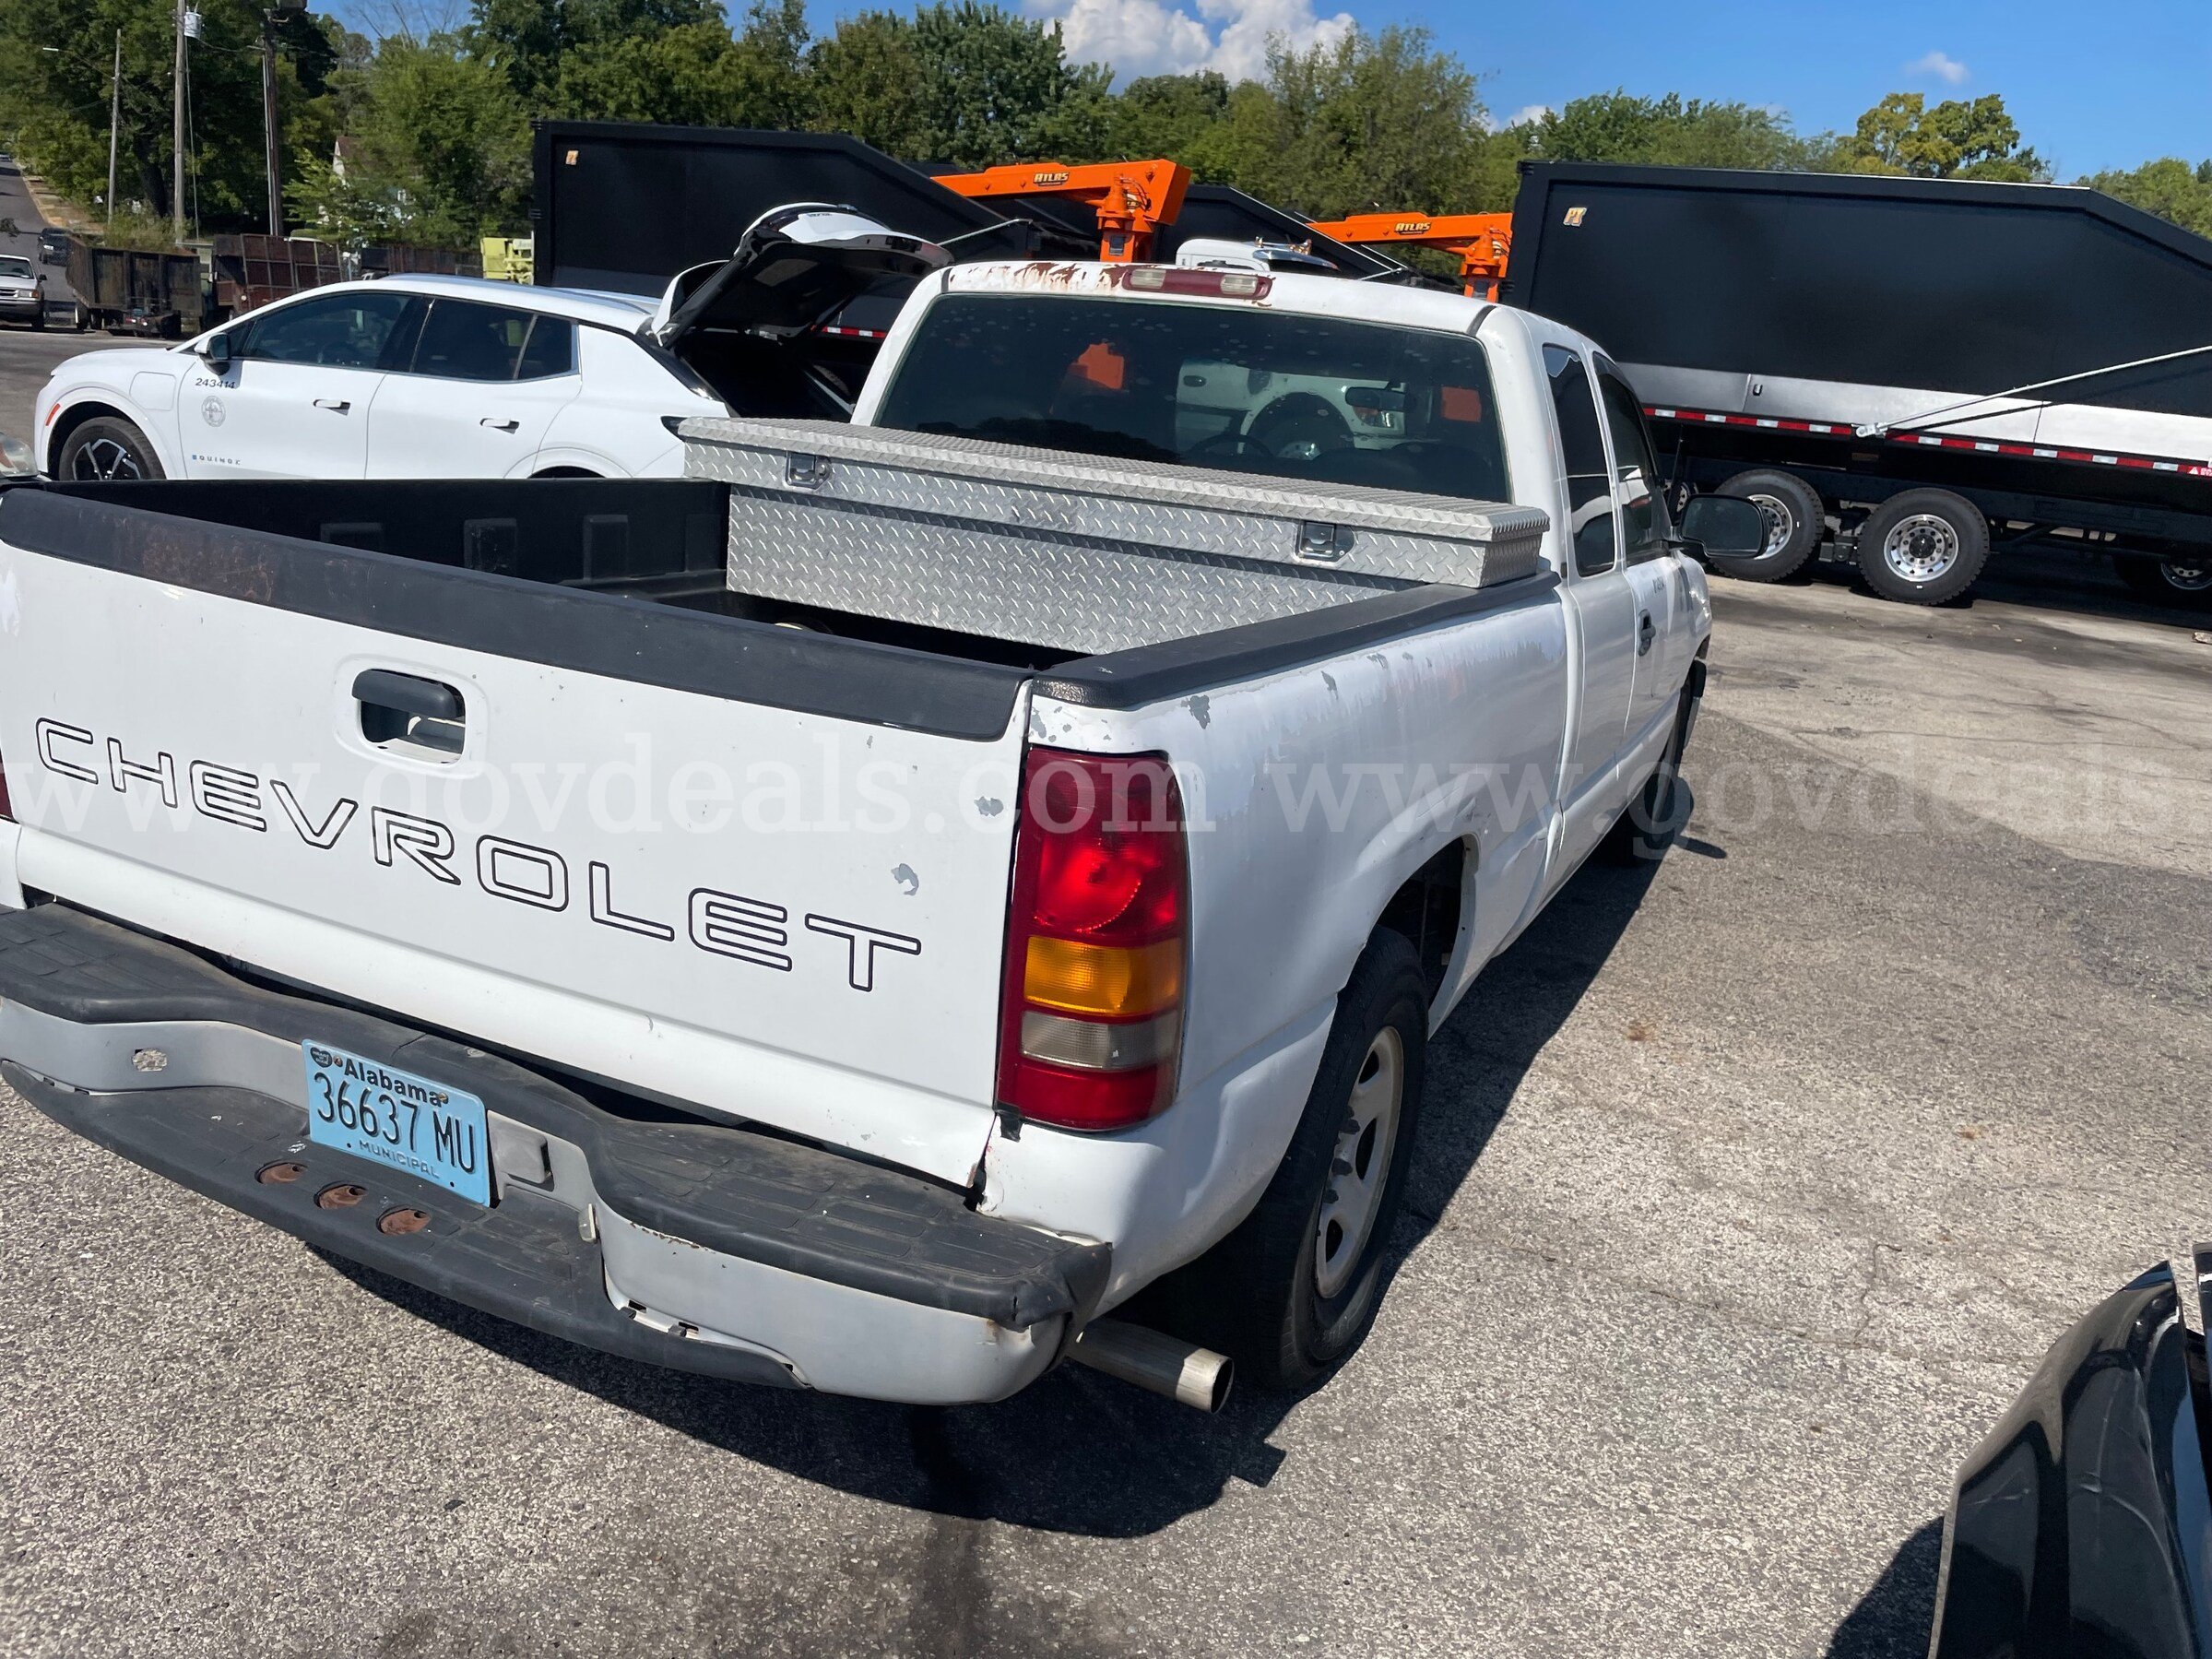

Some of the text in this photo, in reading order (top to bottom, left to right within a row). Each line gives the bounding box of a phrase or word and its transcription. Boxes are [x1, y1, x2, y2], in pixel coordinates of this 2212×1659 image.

[1034, 172, 1070, 184] ATLAS
[1394, 222, 1431, 231] ATLAS
[195, 377, 236, 389] 243414
[35, 717, 921, 992] CHEVROLET
[344, 1058, 444, 1108] Alabama
[313, 1072, 476, 1175] 36637 MU
[359, 1138, 442, 1179] MUNICIPAL
